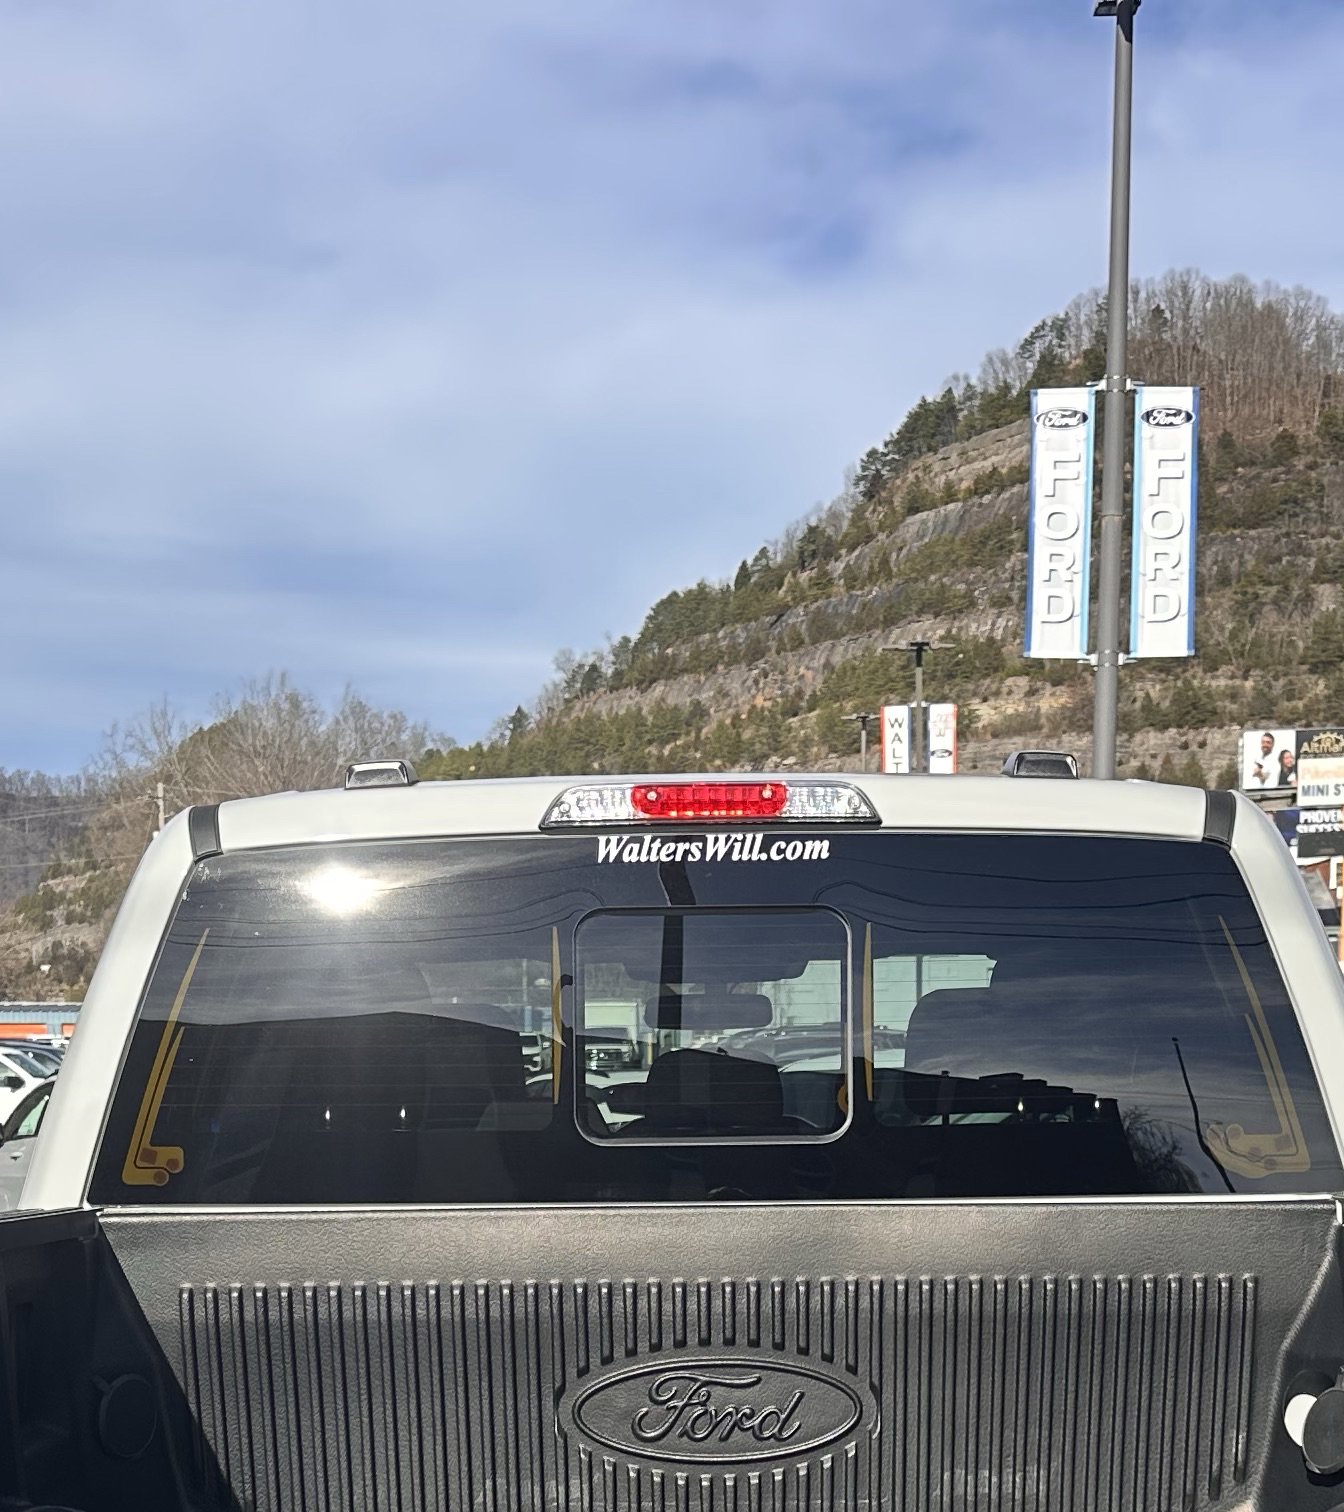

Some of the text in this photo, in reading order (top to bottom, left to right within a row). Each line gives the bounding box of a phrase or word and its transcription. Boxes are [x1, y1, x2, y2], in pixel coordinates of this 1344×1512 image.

[1042, 408, 1083, 428] Ford
[1147, 407, 1187, 427] Ford
[1037, 451, 1081, 624] FORD
[1141, 450, 1186, 623] FORD
[1301, 785, 1329, 797] MINI
[596, 833, 830, 863] WaltersWill.com
[631, 1371, 805, 1441] Ford
